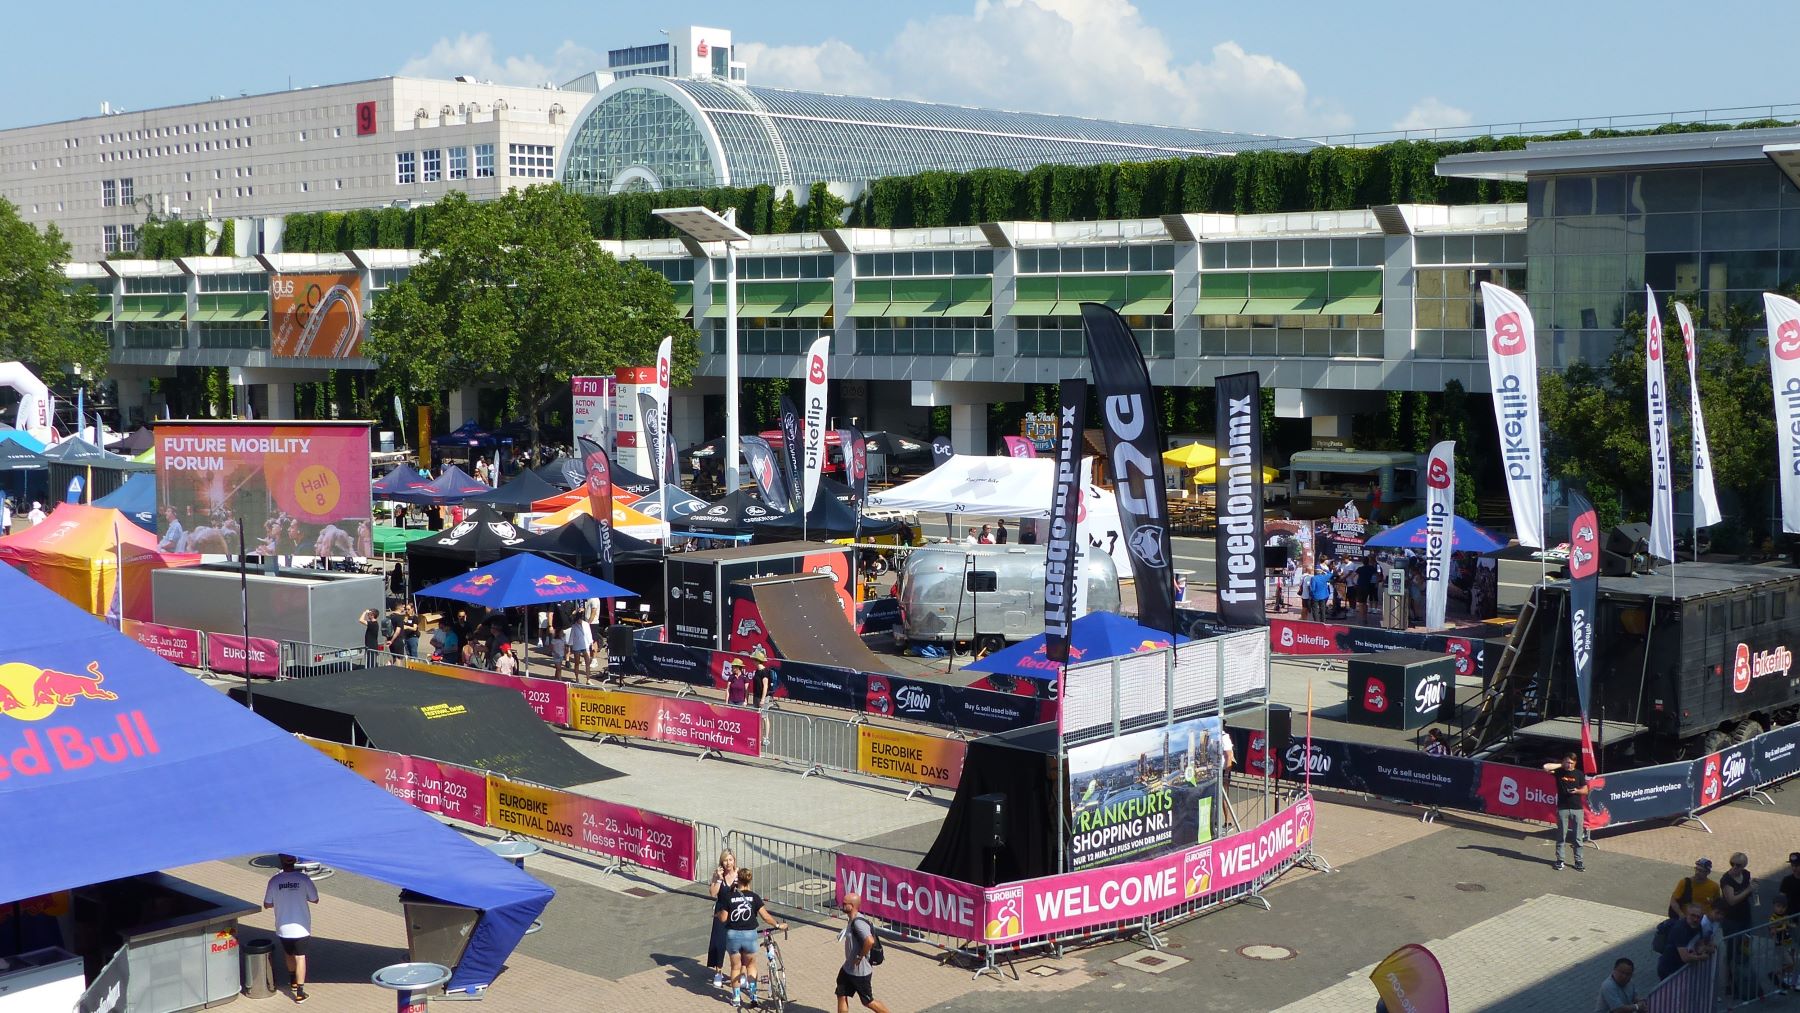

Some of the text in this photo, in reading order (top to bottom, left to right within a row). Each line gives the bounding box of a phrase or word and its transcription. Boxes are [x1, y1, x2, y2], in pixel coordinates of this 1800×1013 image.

[360, 104, 372, 131] 9
[583, 381, 597, 393] F10
[806, 397, 823, 470] bikeflip
[1026, 422, 1056, 436] FISH
[164, 438, 311, 453] FUTURE MOBILITY
[165, 456, 224, 471] FORUM
[301, 472, 329, 494] Hall
[315, 493, 326, 507] 8
[1219, 394, 1258, 604] freedombmx
[1426, 502, 1449, 582] bikeflip
[157, 645, 184, 659] Frankfurt
[160, 636, 172, 646] Juni
[172, 637, 188, 649] 2023
[1297, 634, 1330, 650] bikeflip
[1355, 639, 1364, 647] The
[1364, 641, 1384, 650] bicycle
[674, 657, 684, 665] used
[684, 658, 697, 667] bikes
[1017, 656, 1048, 669] Red
[1752, 645, 1792, 678] bikeflip
[787, 674, 796, 682] The
[796, 676, 813, 686] bicycle
[813, 679, 842, 690] marketplace
[528, 690, 550, 704] 2023
[895, 685, 930, 710] SHOW
[579, 702, 626, 717] EUROBIKE
[965, 702, 975, 712] Buy
[981, 704, 990, 712] sell
[991, 705, 1004, 714] used
[1005, 706, 1020, 717] bikes
[579, 714, 649, 732] FESTIVAL DAYS
[698, 713, 717, 728] Juni
[719, 718, 741, 734] 2023
[47, 710, 160, 771] Bull
[657, 722, 734, 746] Messe Frankfurt
[871, 741, 923, 761] EUROBIKE
[871, 756, 949, 781] FESTIVAL DAYS
[1377, 765, 1391, 776] Buy
[1392, 767, 1399, 775] &
[1400, 767, 1412, 778] sell
[1413, 769, 1430, 780] used
[1431, 771, 1451, 783] bikes
[421, 773, 442, 790] Juni
[444, 781, 467, 799] 2023
[1610, 782, 1682, 801] The bicycle marketplace
[417, 789, 461, 813] Frankfurt
[499, 792, 549, 816] EUROBIKE
[499, 808, 573, 838] FESTIVAL DAYS
[1073, 810, 1173, 854] SHOPPING NR.1
[623, 818, 643, 840] Juni
[646, 828, 673, 849] 2023
[582, 828, 666, 864] Messe Frankfurt
[1073, 830, 1172, 867] NUR 12 MIN. ZU FUSS VON DER MESSE
[1184, 849, 1211, 863] EUROBIKE
[1219, 818, 1293, 877] WELCOME
[840, 867, 974, 928] WELCOME
[985, 889, 1022, 904] EUROBIKE
[1035, 866, 1177, 922] WELCOME
[211, 942, 228, 953] Red
